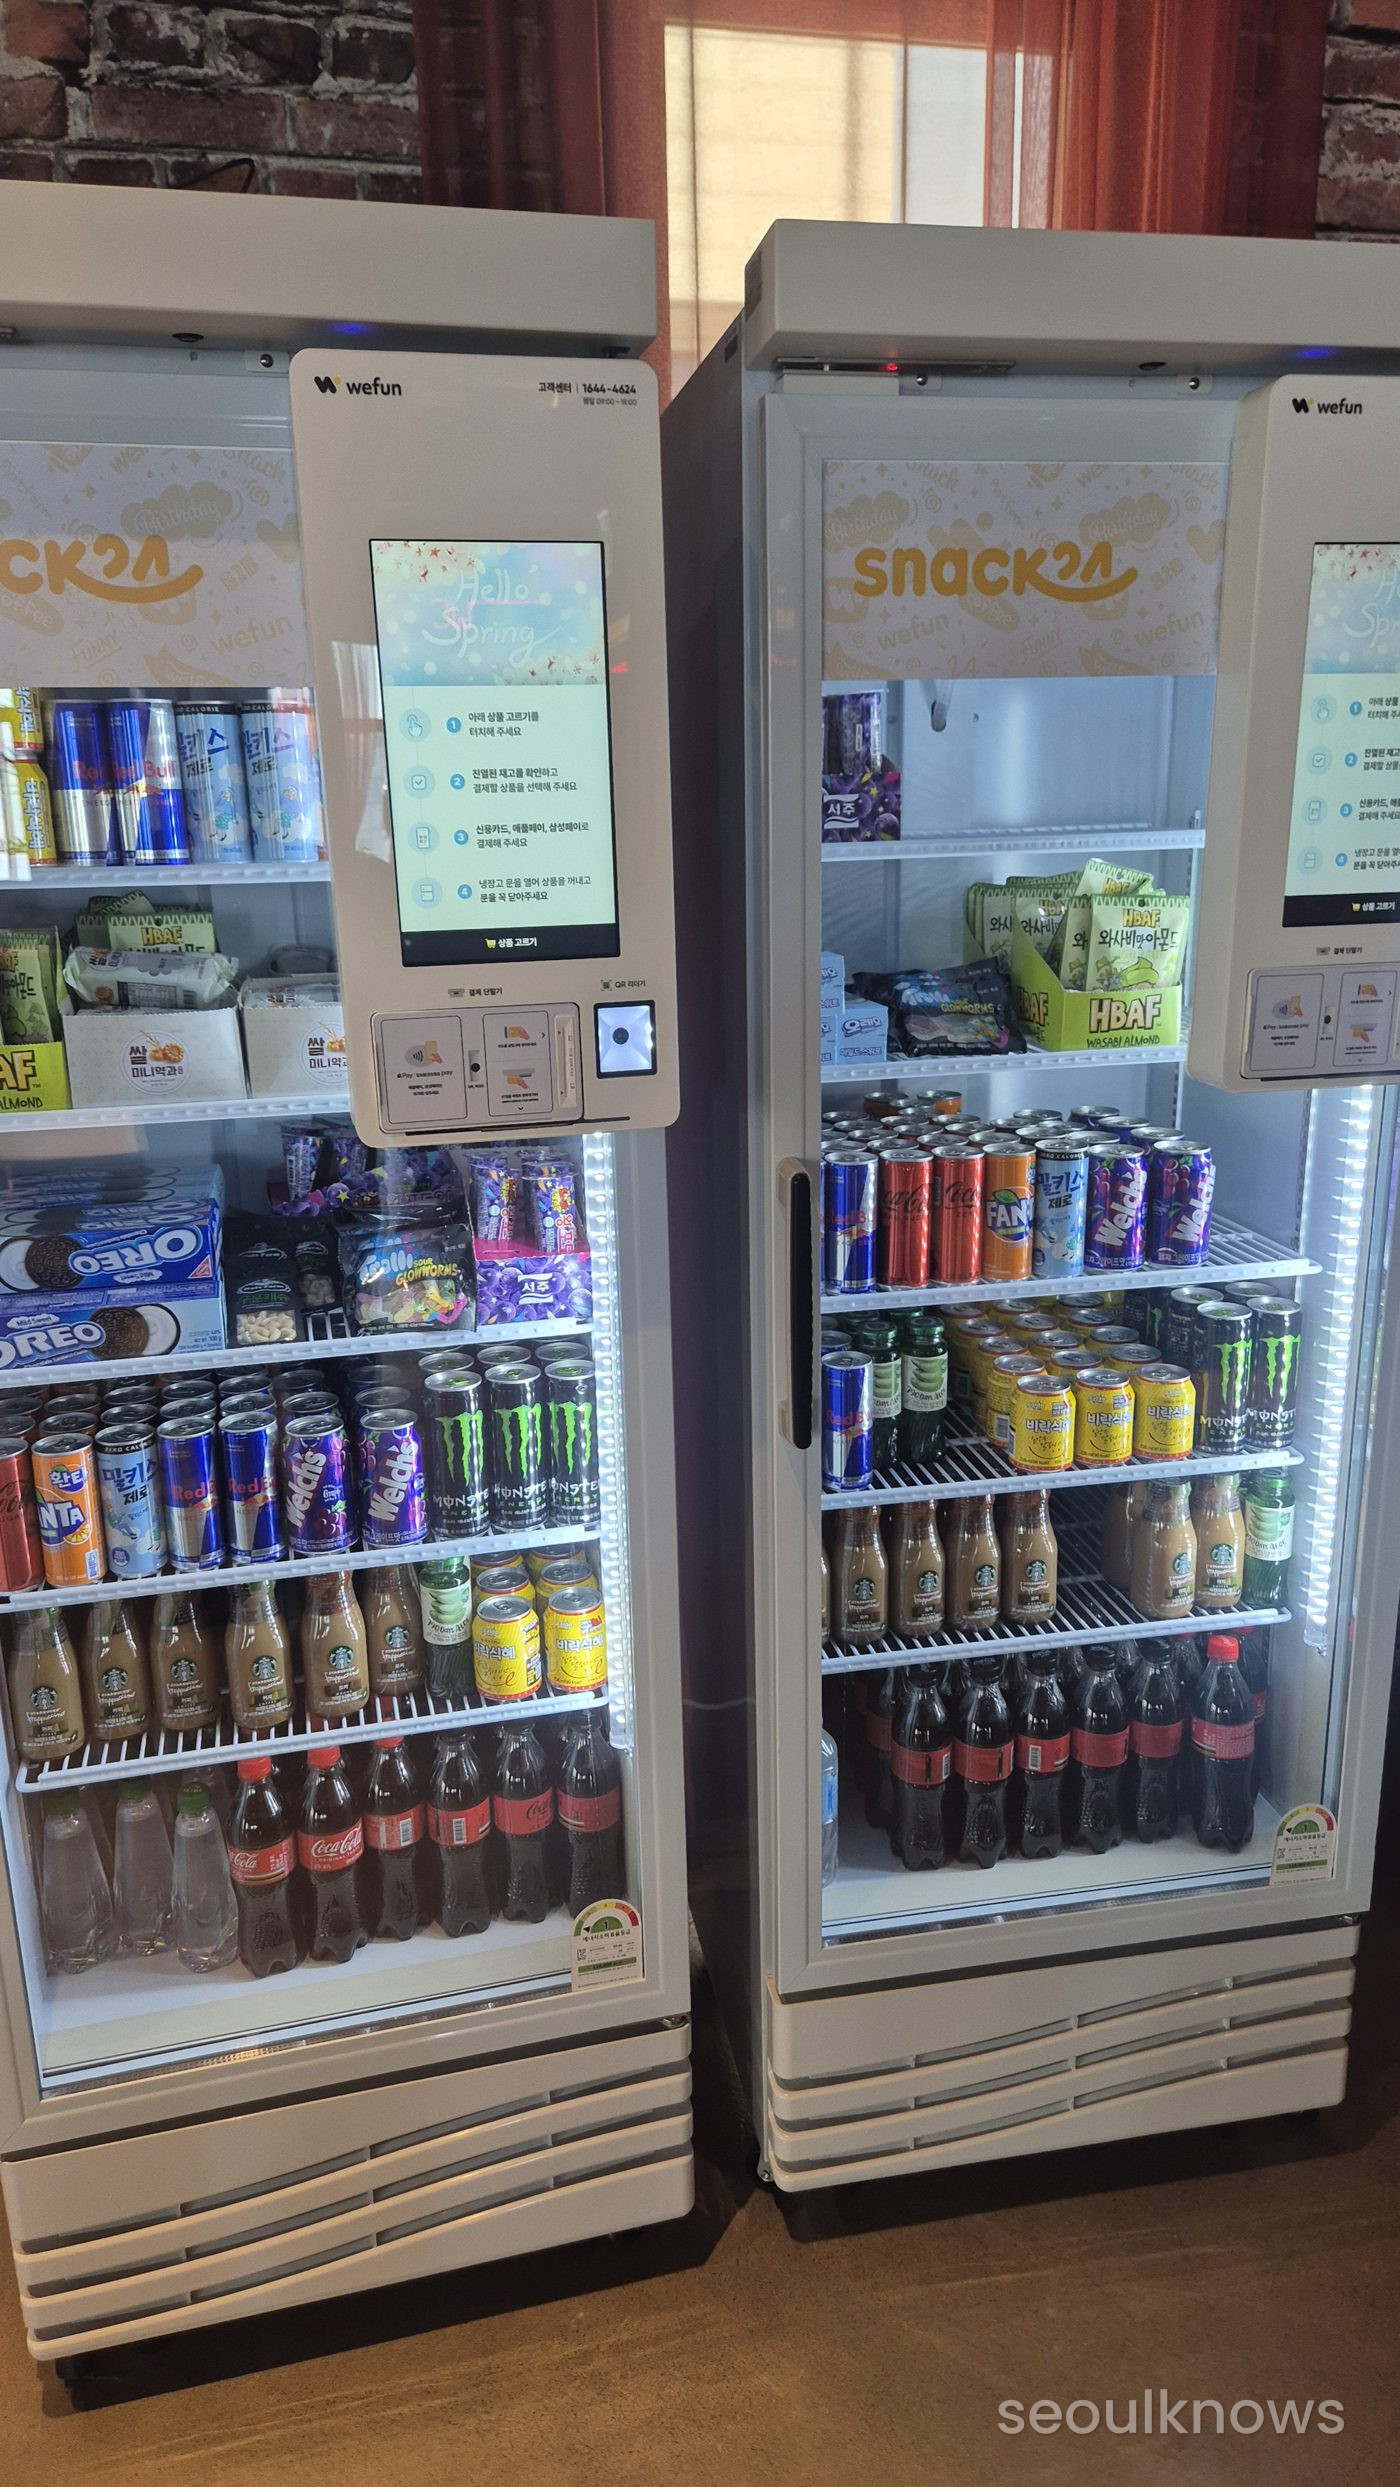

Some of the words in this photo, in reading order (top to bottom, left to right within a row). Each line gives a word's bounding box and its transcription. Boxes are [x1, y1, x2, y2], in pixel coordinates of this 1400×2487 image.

[345, 377, 402, 396] wefun
[538, 382, 572, 393] 고객센터
[582, 383, 637, 394] 1644-4624
[1317, 397, 1363, 415] wefun
[456, 568, 529, 605] Hello
[211, 616, 294, 654] wefun
[422, 606, 562, 668] Spring
[468, 712, 486, 723] 아래
[487, 712, 505, 722] 상품
[505, 711, 539, 722] 고르기를
[469, 726, 495, 737] 터치해
[496, 726, 522, 736] 주세요
[186, 756, 213, 778] 제로
[472, 768, 497, 779] 진열된
[498, 767, 524, 779] 재고를
[525, 767, 558, 778] 확인하고
[473, 782, 498, 794] 결제할
[499, 782, 525, 793] 상품을
[526, 781, 551, 793] 선택해
[552, 781, 577, 791] 주세요
[827, 802, 856, 817] 서주
[549, 821, 589, 832] 삼성페이로
[476, 838, 501, 849] 결제해
[503, 837, 528, 848] 주세요
[478, 878, 504, 889] 냉장고
[506, 878, 521, 888] 문을
[523, 877, 540, 888] 열어
[541, 877, 566, 887] 상품을
[567, 876, 591, 886] 꺼내고
[480, 892, 497, 903] 문을
[498, 892, 507, 902] 꼭
[508, 891, 548, 901] 닫아주세요
[1122, 908, 1161, 928] HBAF
[141, 926, 182, 946] HBAF
[498, 938, 513, 948] 상품
[514, 937, 538, 947] 고르기
[1098, 927, 1179, 951] 와사비맛아몬드
[614, 981, 627, 989] QR
[1089, 993, 1162, 1033] HBAF
[842, 1017, 882, 1037] 오레오
[308, 1037, 325, 1056] 쌀
[1086, 1036, 1122, 1048] WASABI
[1124, 1034, 1160, 1046] ALMOND
[129, 1046, 148, 1065] 쌀
[131, 1066, 177, 1078] 미니약과
[1047, 1194, 1073, 1210] 제로
[72, 1229, 198, 1275] OREO
[414, 1257, 434, 1267] SOUR
[395, 1263, 458, 1286] GLOWWORMS
[521, 1280, 549, 1293] 서주
[16, 1317, 32, 1327] Mild
[33, 1315, 52, 1325] Sweet
[286, 1449, 327, 1528] Welch's
[368, 1440, 419, 1522] Welch's
[556, 1633, 603, 1653] 비락식혜
